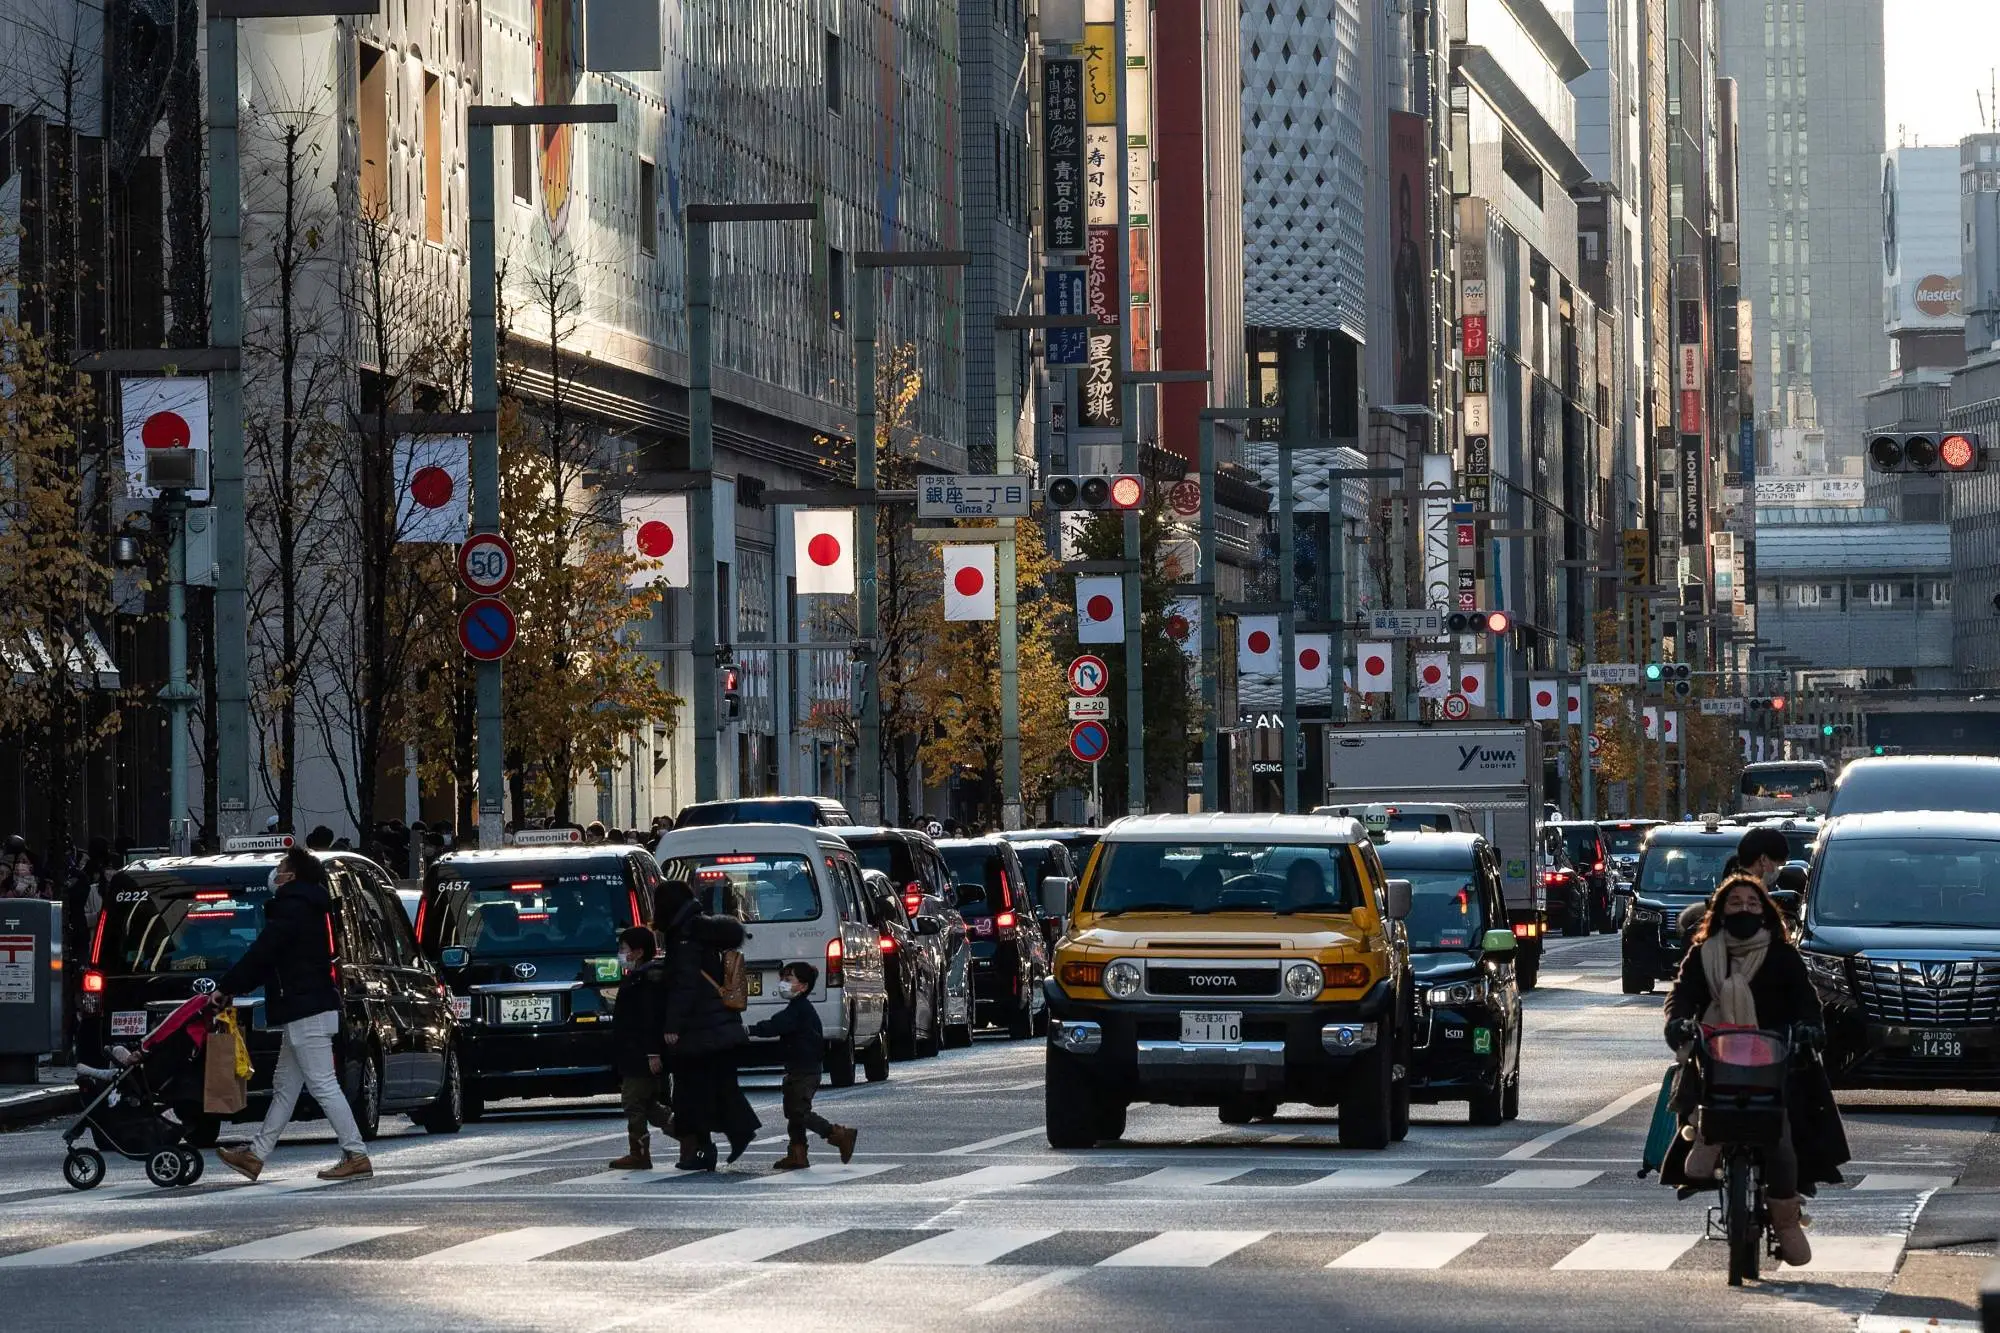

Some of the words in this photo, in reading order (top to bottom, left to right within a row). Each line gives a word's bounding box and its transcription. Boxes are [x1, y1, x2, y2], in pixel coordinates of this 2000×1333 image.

[1049, 64, 1061, 121] 中国料理
[1053, 160, 1075, 245] 青百合飯荘
[1088, 236, 1107, 320] おたからや
[1103, 314, 1118, 325] 3F
[1466, 317, 1482, 349] まつげ
[1086, 334, 1115, 421] 星乃珈琲
[1468, 361, 1485, 393] 歯科
[1474, 437, 1488, 473] Oasis
[925, 476, 956, 486] 中央区
[1686, 450, 1698, 521] MONTBLANC
[926, 486, 1022, 504] 銀座二丁目
[955, 504, 982, 514] Ginza
[986, 504, 993, 513] 2
[471, 551, 503, 578] 50
[1375, 616, 1437, 629] 銀座三丁目
[1448, 701, 1464, 714] 50
[1457, 745, 1516, 771] YUWA
[438, 881, 471, 893] 6457
[115, 890, 149, 903] 6222
[1188, 975, 1237, 986] TOYOTA
[511, 1007, 550, 1022] 64-57
[1924, 1041, 1961, 1056] 14-98
